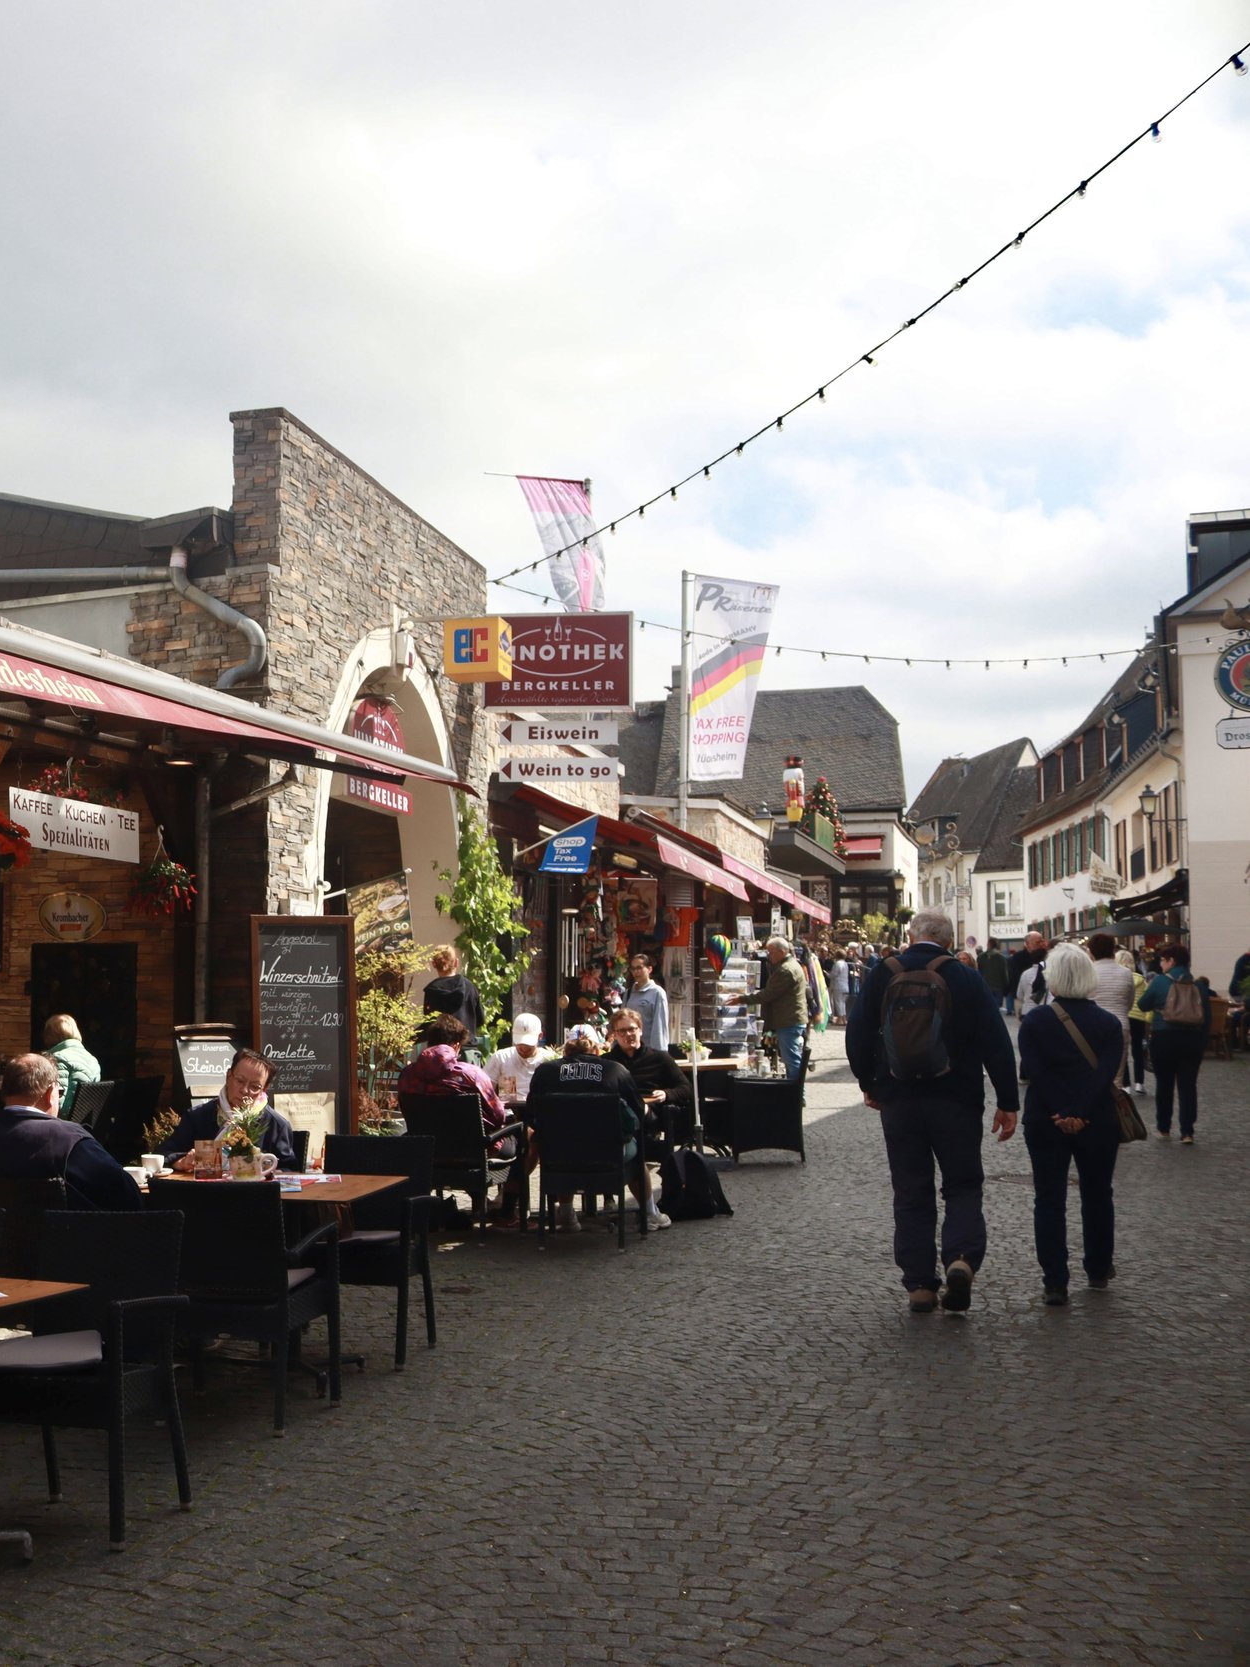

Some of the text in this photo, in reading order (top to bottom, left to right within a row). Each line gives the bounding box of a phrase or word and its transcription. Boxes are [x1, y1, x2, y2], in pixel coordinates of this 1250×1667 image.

[511, 643, 625, 661] INOTHEK
[501, 680, 616, 691] BERGKELLER
[716, 715, 746, 729] FREE
[528, 726, 599, 740] Eiswein
[518, 763, 611, 778] Wein to go
[13, 793, 136, 831] KAFFEE KUCHEN TEE
[555, 838, 583, 847] Shop
[52, 911, 90, 922] Krombacher
[393, 922, 409, 931] GO
[259, 956, 343, 983] Winzerschnitzel
[263, 1044, 316, 1059] Omelette
[184, 1057, 231, 1076] Steinof
[559, 1062, 603, 1082] CELTICS
